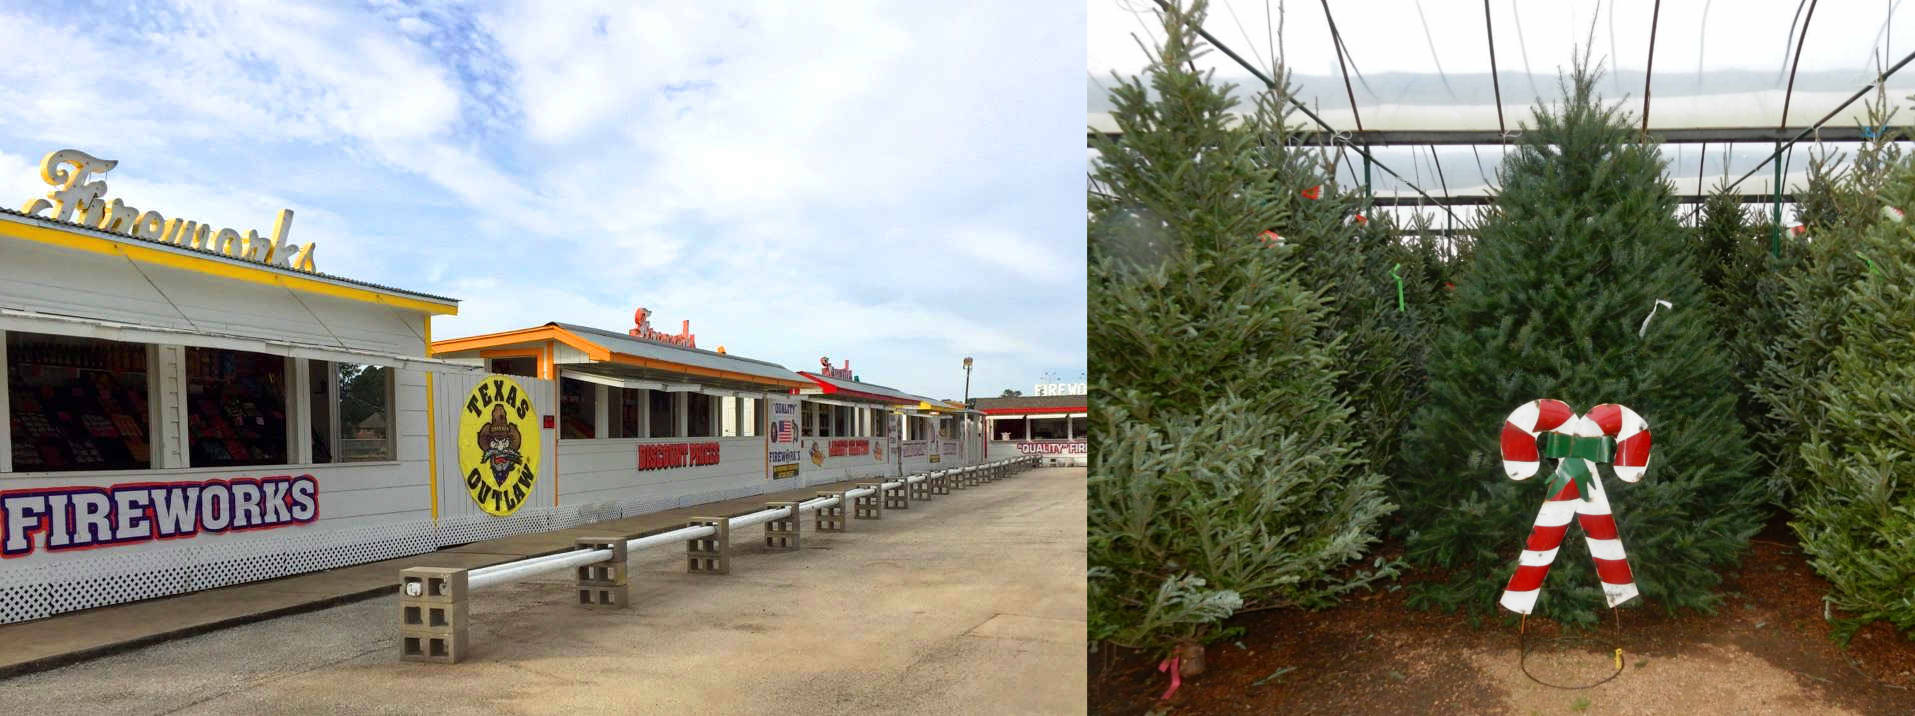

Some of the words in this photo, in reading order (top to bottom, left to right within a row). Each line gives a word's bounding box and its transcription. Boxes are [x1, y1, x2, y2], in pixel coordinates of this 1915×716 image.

[20, 149, 317, 275] Fireworks
[466, 380, 529, 420] TEXAS
[638, 443, 688, 471] DISCOUNT
[689, 441, 720, 467] PRICES
[467, 463, 534, 512] OUTLAW
[2, 476, 316, 554] FIREWORKS
